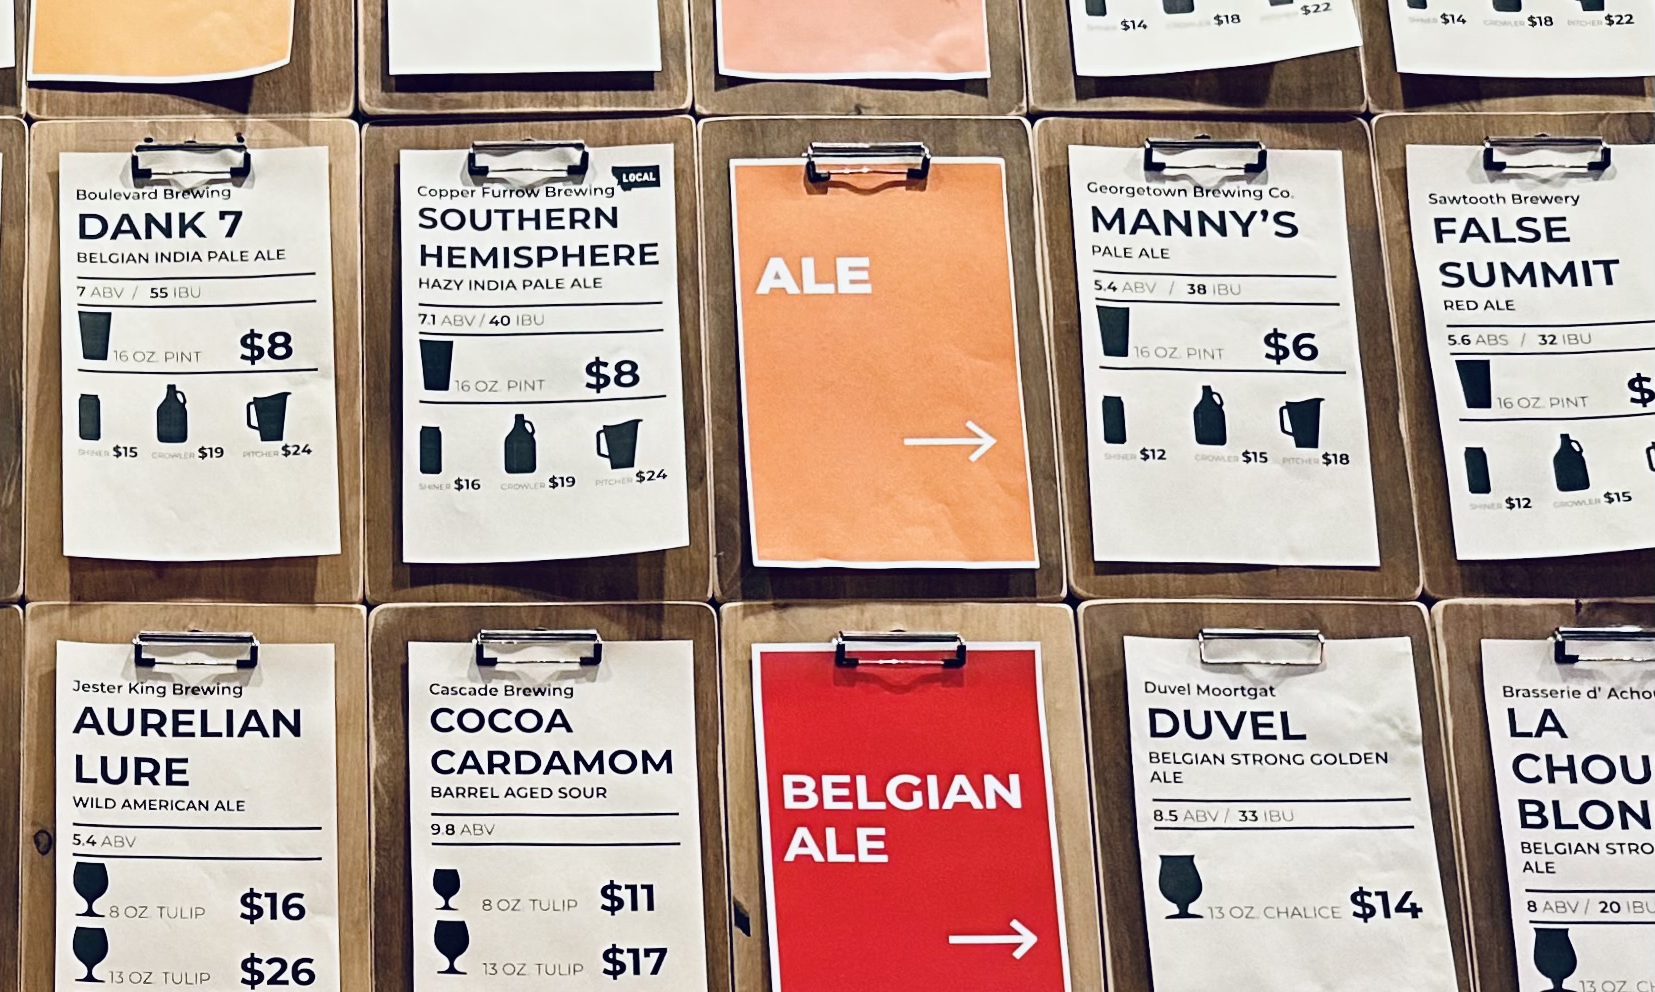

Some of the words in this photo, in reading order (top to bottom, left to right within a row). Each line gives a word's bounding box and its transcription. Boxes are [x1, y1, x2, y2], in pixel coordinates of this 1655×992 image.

[1440, 13, 1466, 25] $14
[1527, 15, 1553, 28] $18
[1605, 13, 1634, 27] $22
[622, 172, 656, 183] LOCAL
[77, 189, 157, 200] Boulevard
[163, 187, 232, 202] Brewing
[418, 186, 476, 200] Copper
[481, 185, 540, 199] Furrow
[545, 184, 614, 198] Brewing
[1087, 182, 1187, 198] Georgetown
[1193, 185, 1264, 201] Brewing
[1429, 193, 1506, 205] Sawtooth
[1512, 194, 1580, 206] Brewery
[79, 211, 207, 240] DANK
[219, 211, 243, 238] 7
[419, 206, 618, 231] SOUTHERN
[1091, 206, 1298, 238] MANNY'S
[1434, 216, 1570, 244] FALSE
[421, 242, 659, 269] HEMISPHERE
[1092, 245, 1133, 258] PALE
[1138, 248, 1170, 259] ALE
[754, 256, 872, 295] ALE
[1439, 259, 1620, 288] SUMMIT
[1444, 300, 1478, 311] RED
[1484, 300, 1516, 311] ALE
[240, 329, 293, 365] $8
[1264, 328, 1318, 365] $6
[585, 356, 640, 394] $8
[73, 680, 123, 694] Jester
[127, 680, 167, 699] King
[172, 681, 243, 700] Brewing
[429, 681, 499, 697] Cascade
[504, 683, 574, 700] Brewing
[1145, 681, 1190, 695] Duvel
[1197, 682, 1277, 699] Moortgat
[1503, 686, 1581, 699] Brasserie
[72, 706, 301, 738] AURELIAN
[430, 707, 573, 733] COCOA
[1148, 708, 1307, 740] DUVEL
[1507, 708, 1569, 739] LA
[76, 754, 189, 786] LURE
[431, 749, 673, 775] CARDAMOM
[1149, 752, 1225, 765] BELGIAN
[1231, 753, 1304, 766] STRONG
[1310, 751, 1388, 765] GOLDEN
[1512, 753, 1651, 785] CHOU
[1150, 771, 1183, 783] ALE
[73, 796, 116, 809] WILD
[121, 799, 209, 811] AMERICAN
[214, 800, 245, 811] ALE
[431, 786, 499, 798] BARREL
[504, 787, 553, 798] AGED
[558, 787, 607, 799] SOUR
[782, 773, 1021, 811] BELGIAN
[1518, 799, 1651, 830] BLON
[783, 825, 889, 864] ALE
[240, 888, 306, 925] $16
[600, 880, 654, 916] $11
[1350, 886, 1423, 923] $14
[241, 953, 316, 990] $26
[602, 944, 667, 980] $17
